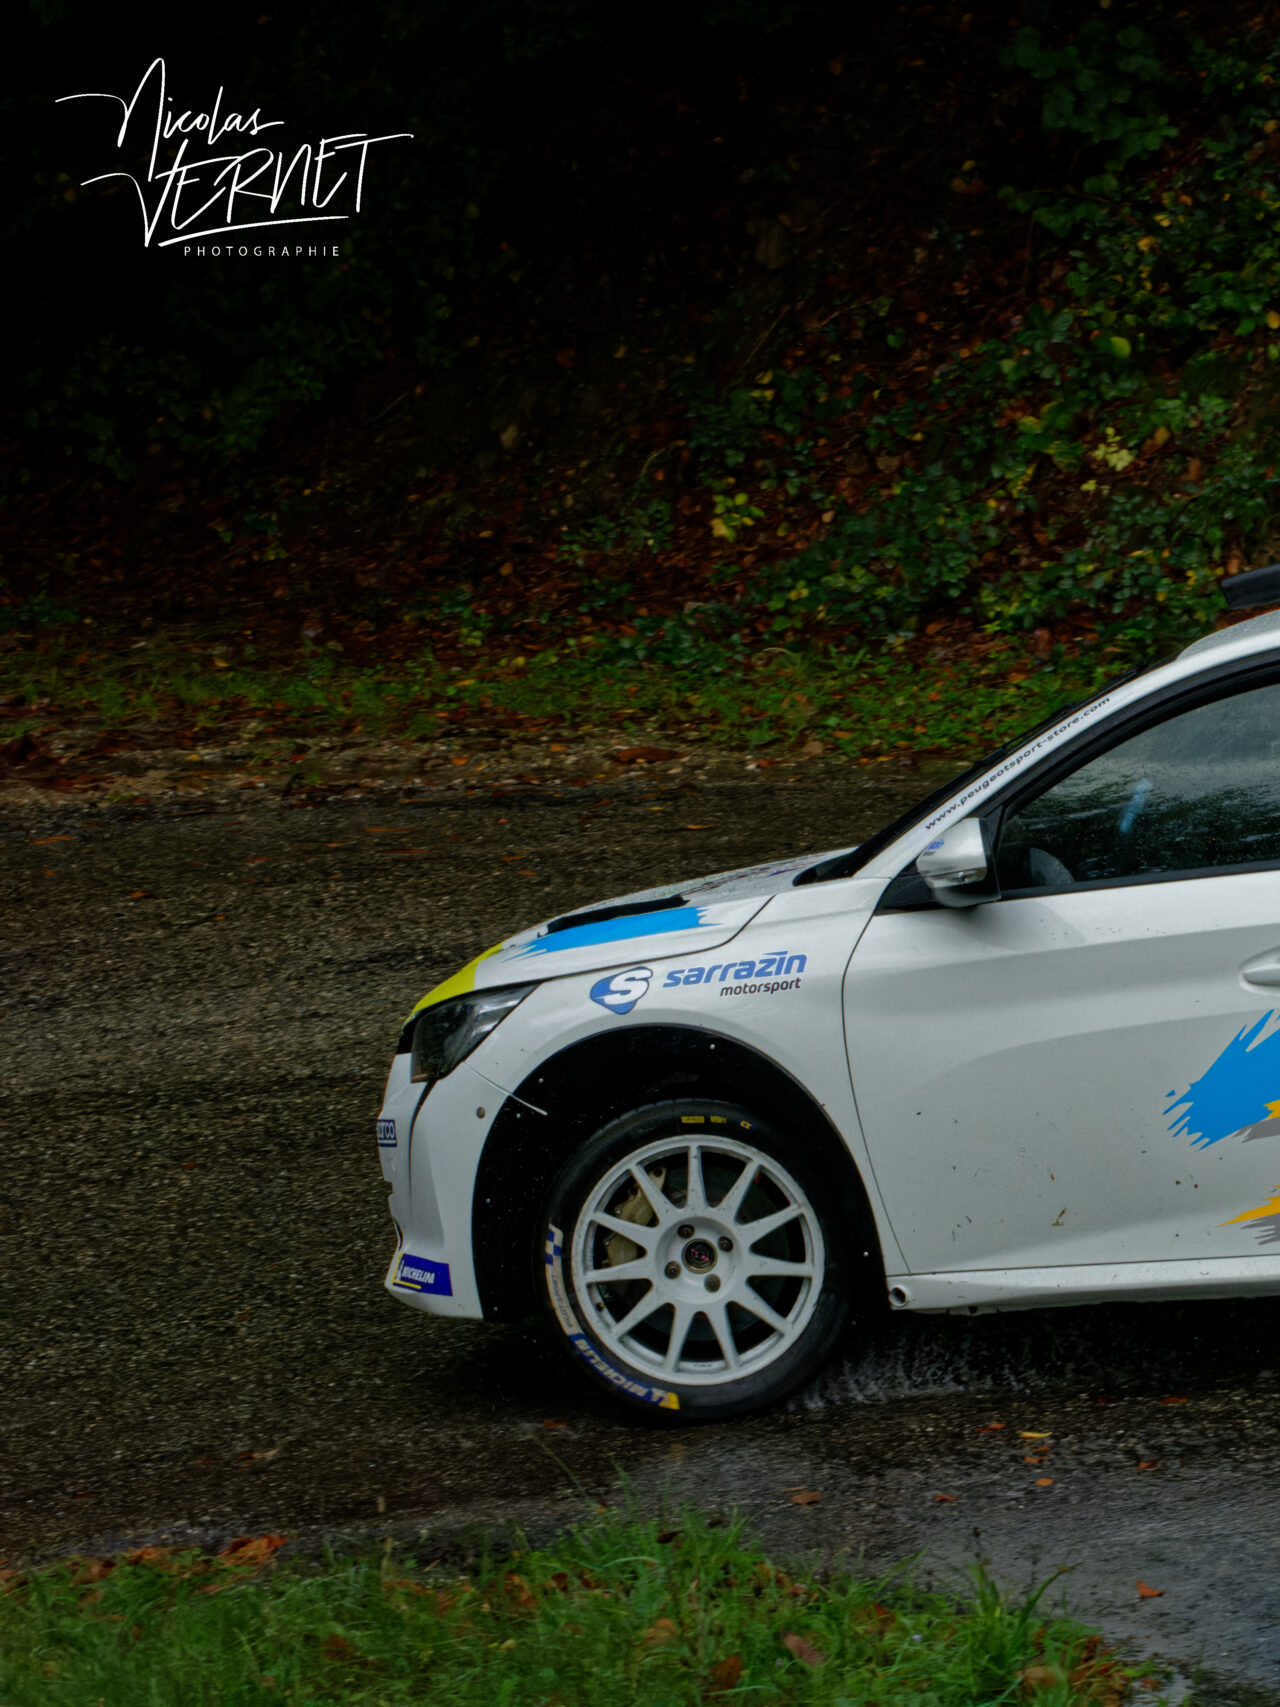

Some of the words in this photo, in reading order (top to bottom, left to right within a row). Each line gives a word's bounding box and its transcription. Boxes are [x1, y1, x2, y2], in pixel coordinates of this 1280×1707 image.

[925, 697, 1110, 830] www.peugeotsport-store.com
[662, 950, 807, 988] sarrazin
[720, 977, 802, 997] motorsport
